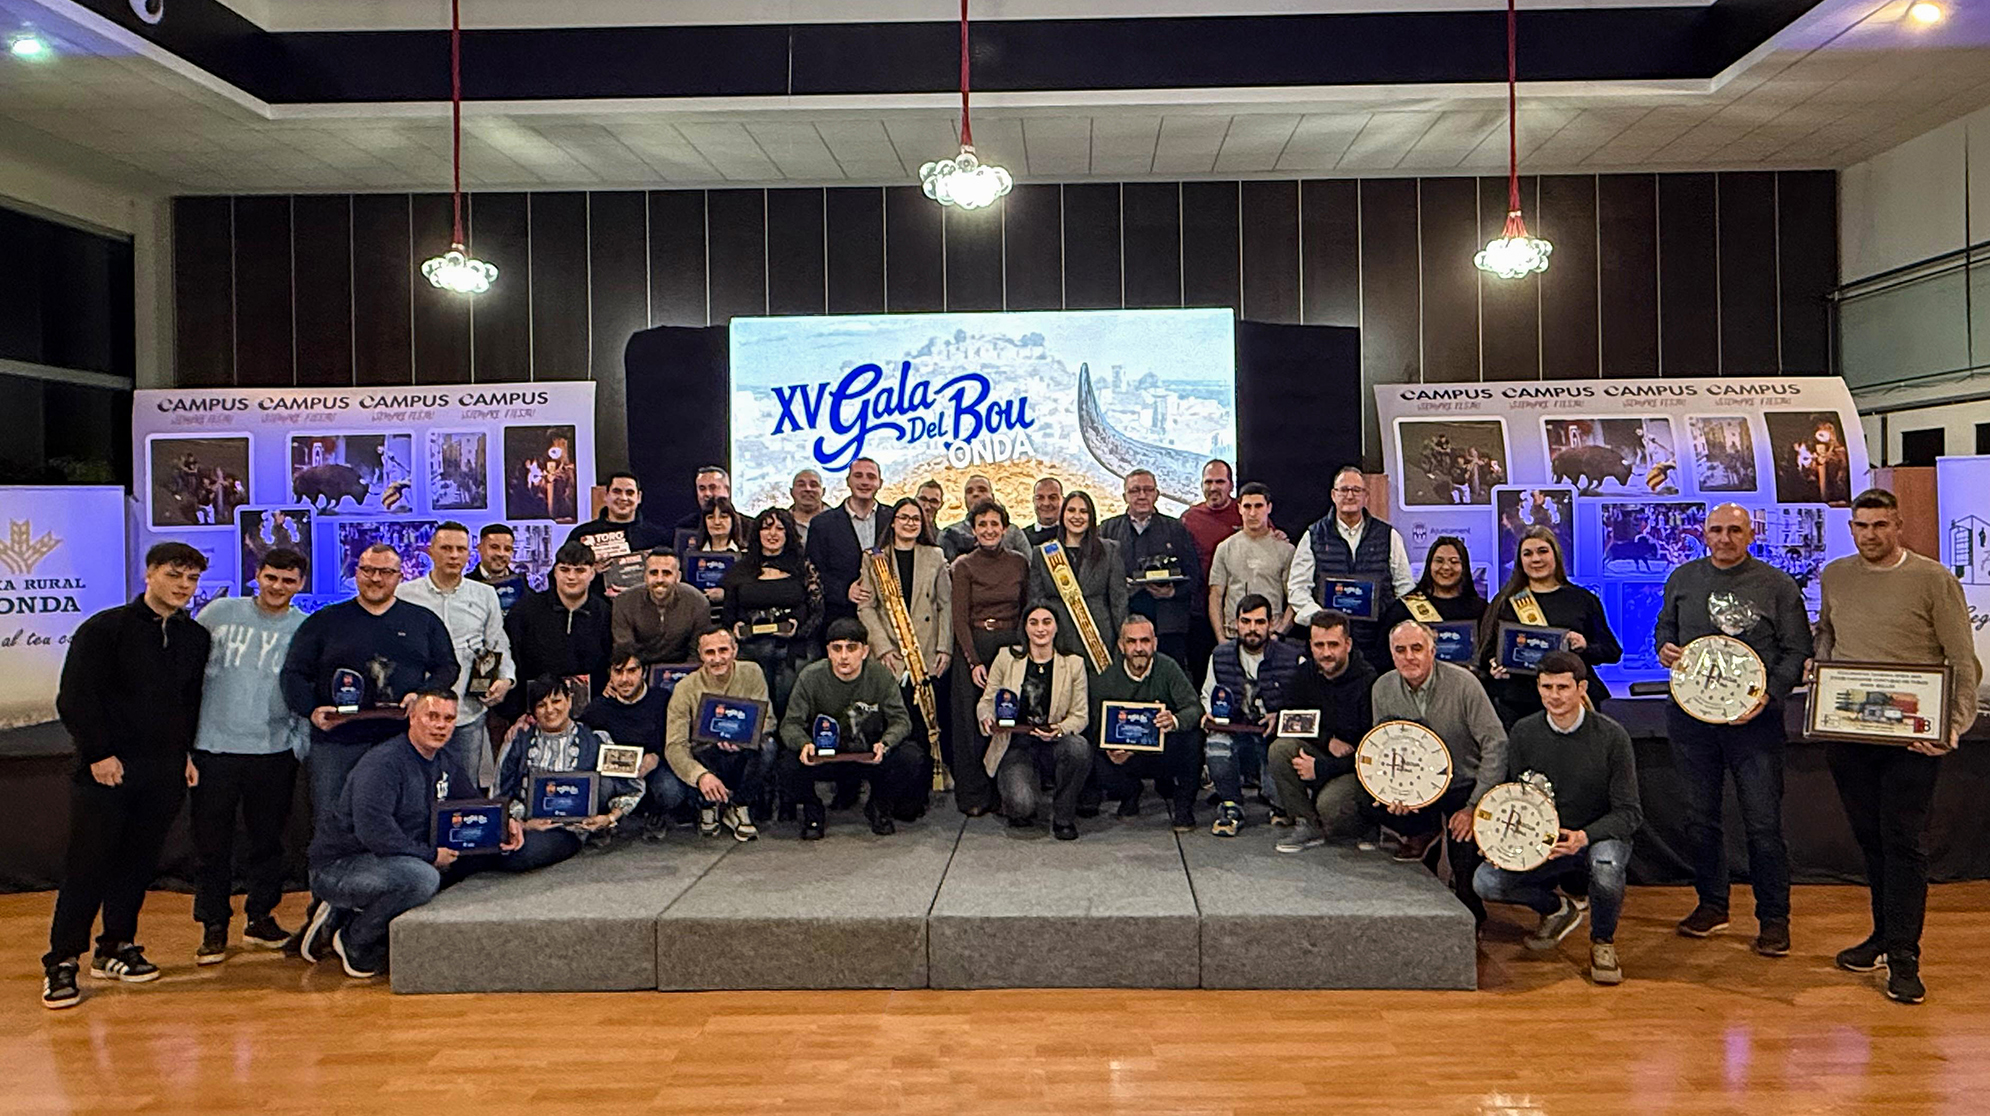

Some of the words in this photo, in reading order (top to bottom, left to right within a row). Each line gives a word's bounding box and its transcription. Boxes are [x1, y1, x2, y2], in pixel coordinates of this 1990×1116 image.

[1400, 389, 1493, 401] CAMPUS
[1502, 386, 1595, 399] CAMPUS
[1603, 385, 1698, 397] CAMPUS
[1706, 384, 1801, 396] CAMPUS
[157, 398, 249, 412] CAMPUS
[258, 396, 350, 411] CAMPUS
[359, 394, 450, 409] CAMPUS
[458, 392, 549, 406] CAMPUS
[771, 382, 830, 435] XV
[813, 360, 937, 473] Gala
[907, 411, 948, 444] Del
[934, 372, 1035, 451] Bou
[949, 431, 1035, 469] ONDA
[595, 531, 625, 543] TORO
[25, 578, 86, 590] RURAL
[0, 596, 81, 614] ONDA
[2, 628, 23, 647] al
